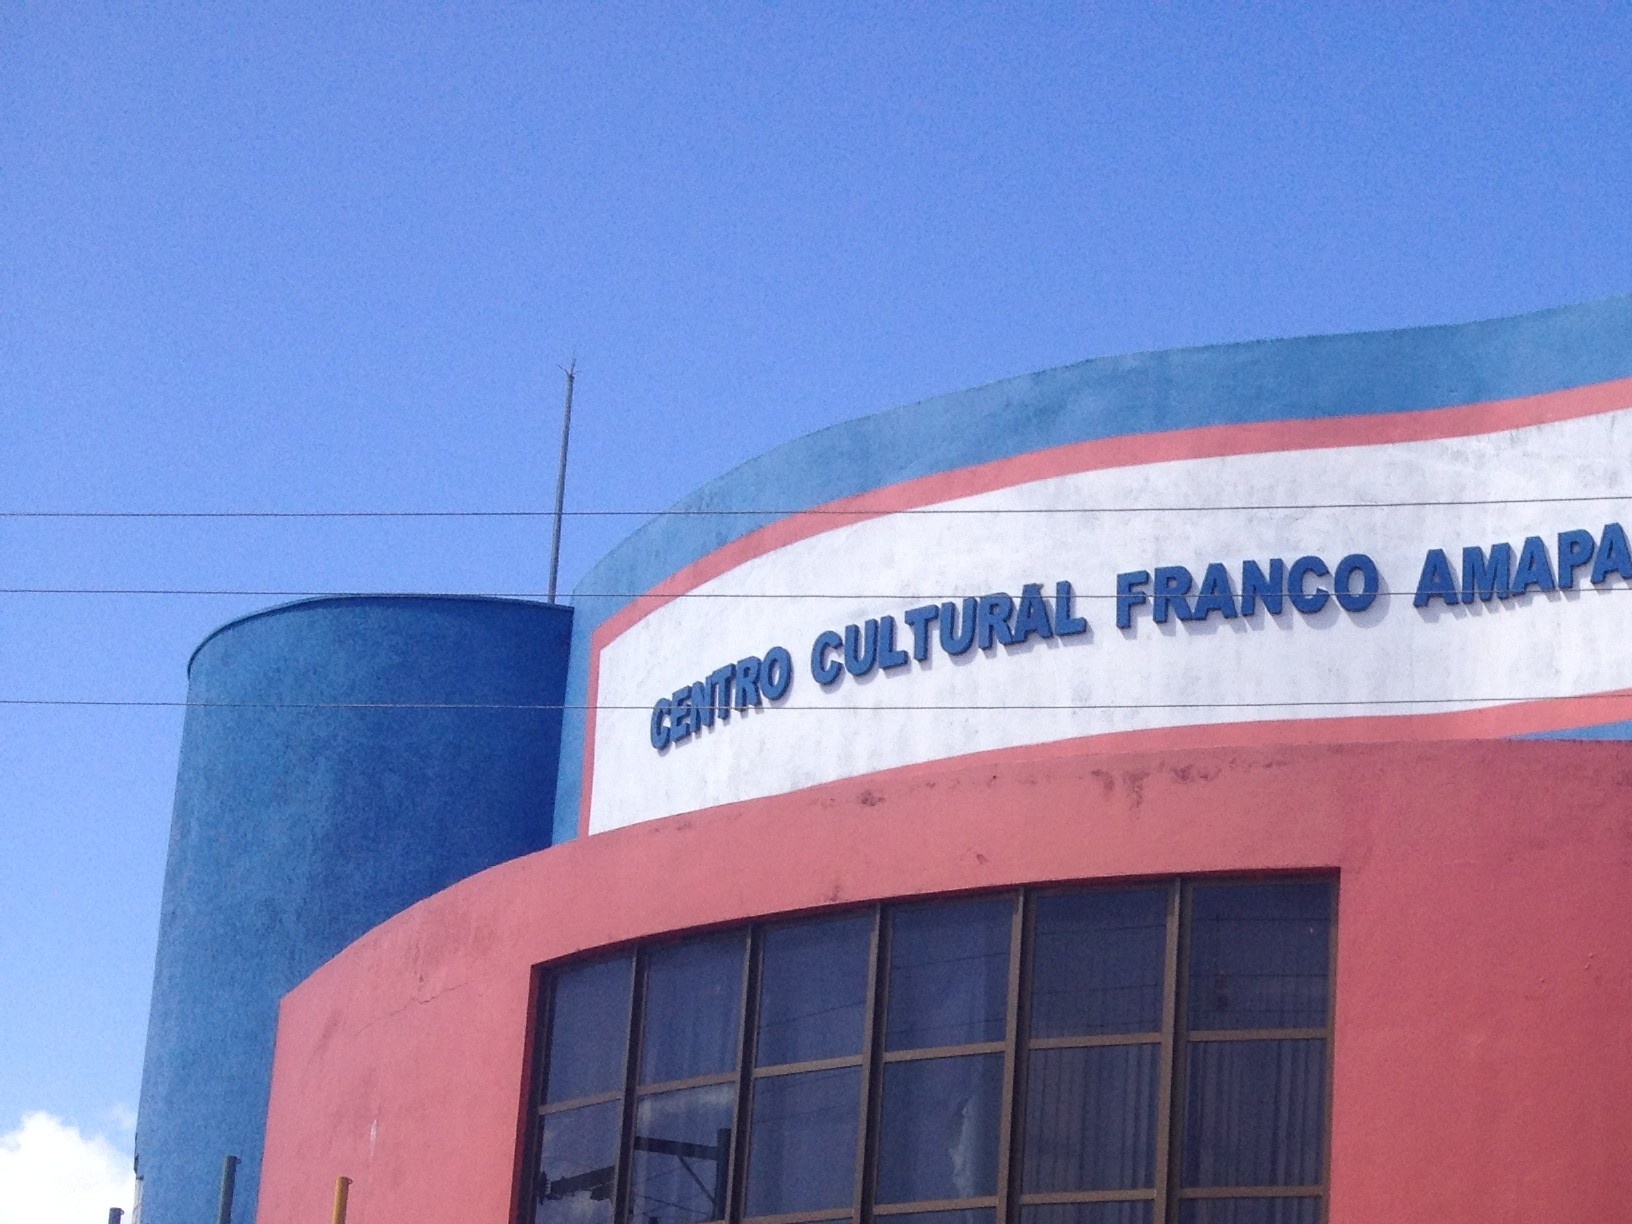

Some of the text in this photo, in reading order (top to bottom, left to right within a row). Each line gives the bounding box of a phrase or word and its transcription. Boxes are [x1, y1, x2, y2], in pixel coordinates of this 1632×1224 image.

[651, 646, 792, 751] CENTRO
[811, 580, 1087, 687] CULTURAL
[1116, 554, 1380, 630] FRANCO
